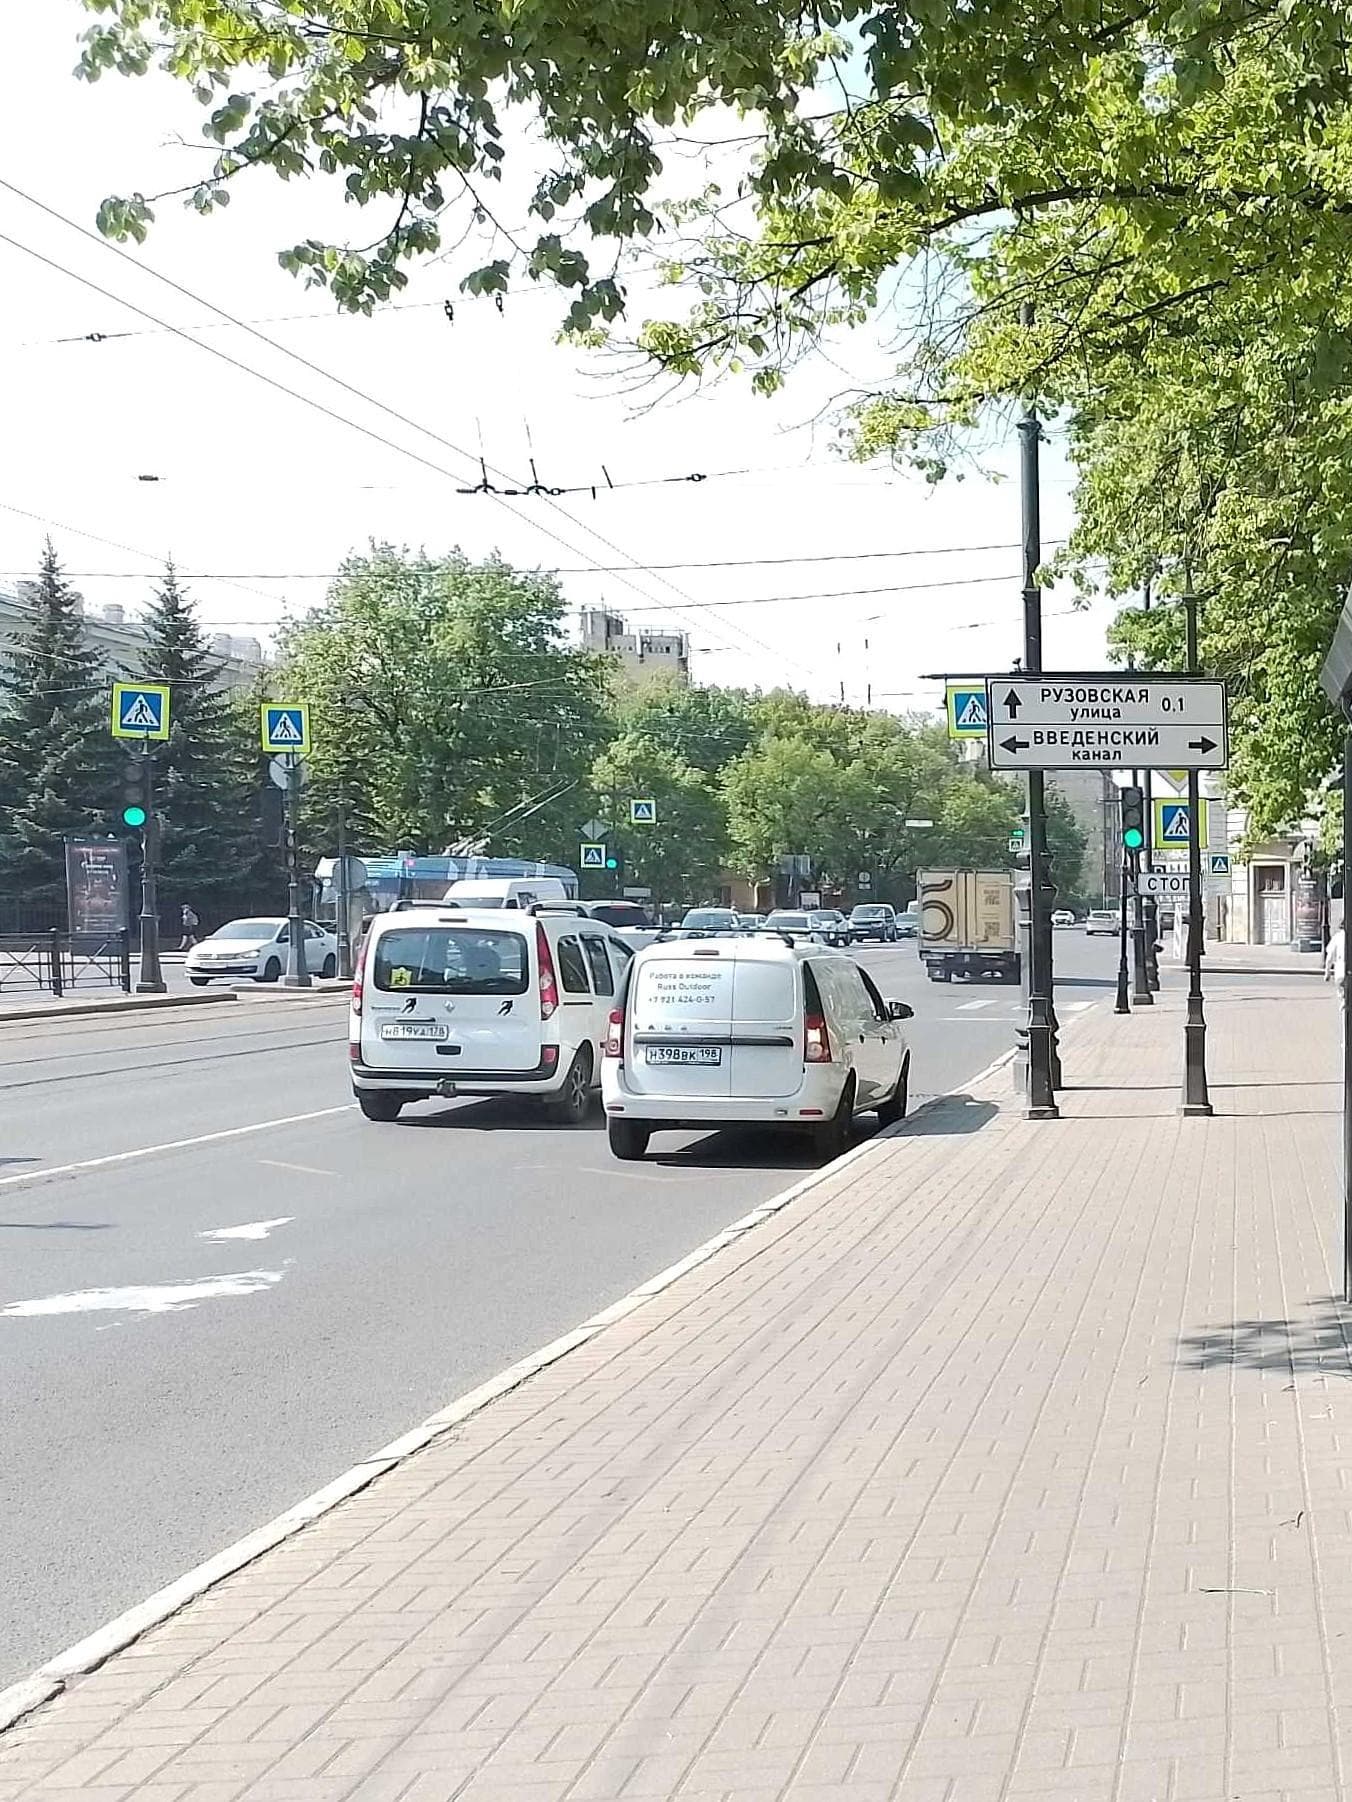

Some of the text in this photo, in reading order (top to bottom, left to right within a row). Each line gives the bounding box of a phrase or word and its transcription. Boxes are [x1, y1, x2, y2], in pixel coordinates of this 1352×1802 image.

[1040, 688, 1149, 703] РУЗОВСКАЯ
[1161, 697, 1184, 712] 0.1
[1070, 707, 1121, 721] улица
[1033, 727, 1159, 746] ВВЕДЕНСКИЙ
[1072, 750, 1122, 761] канал
